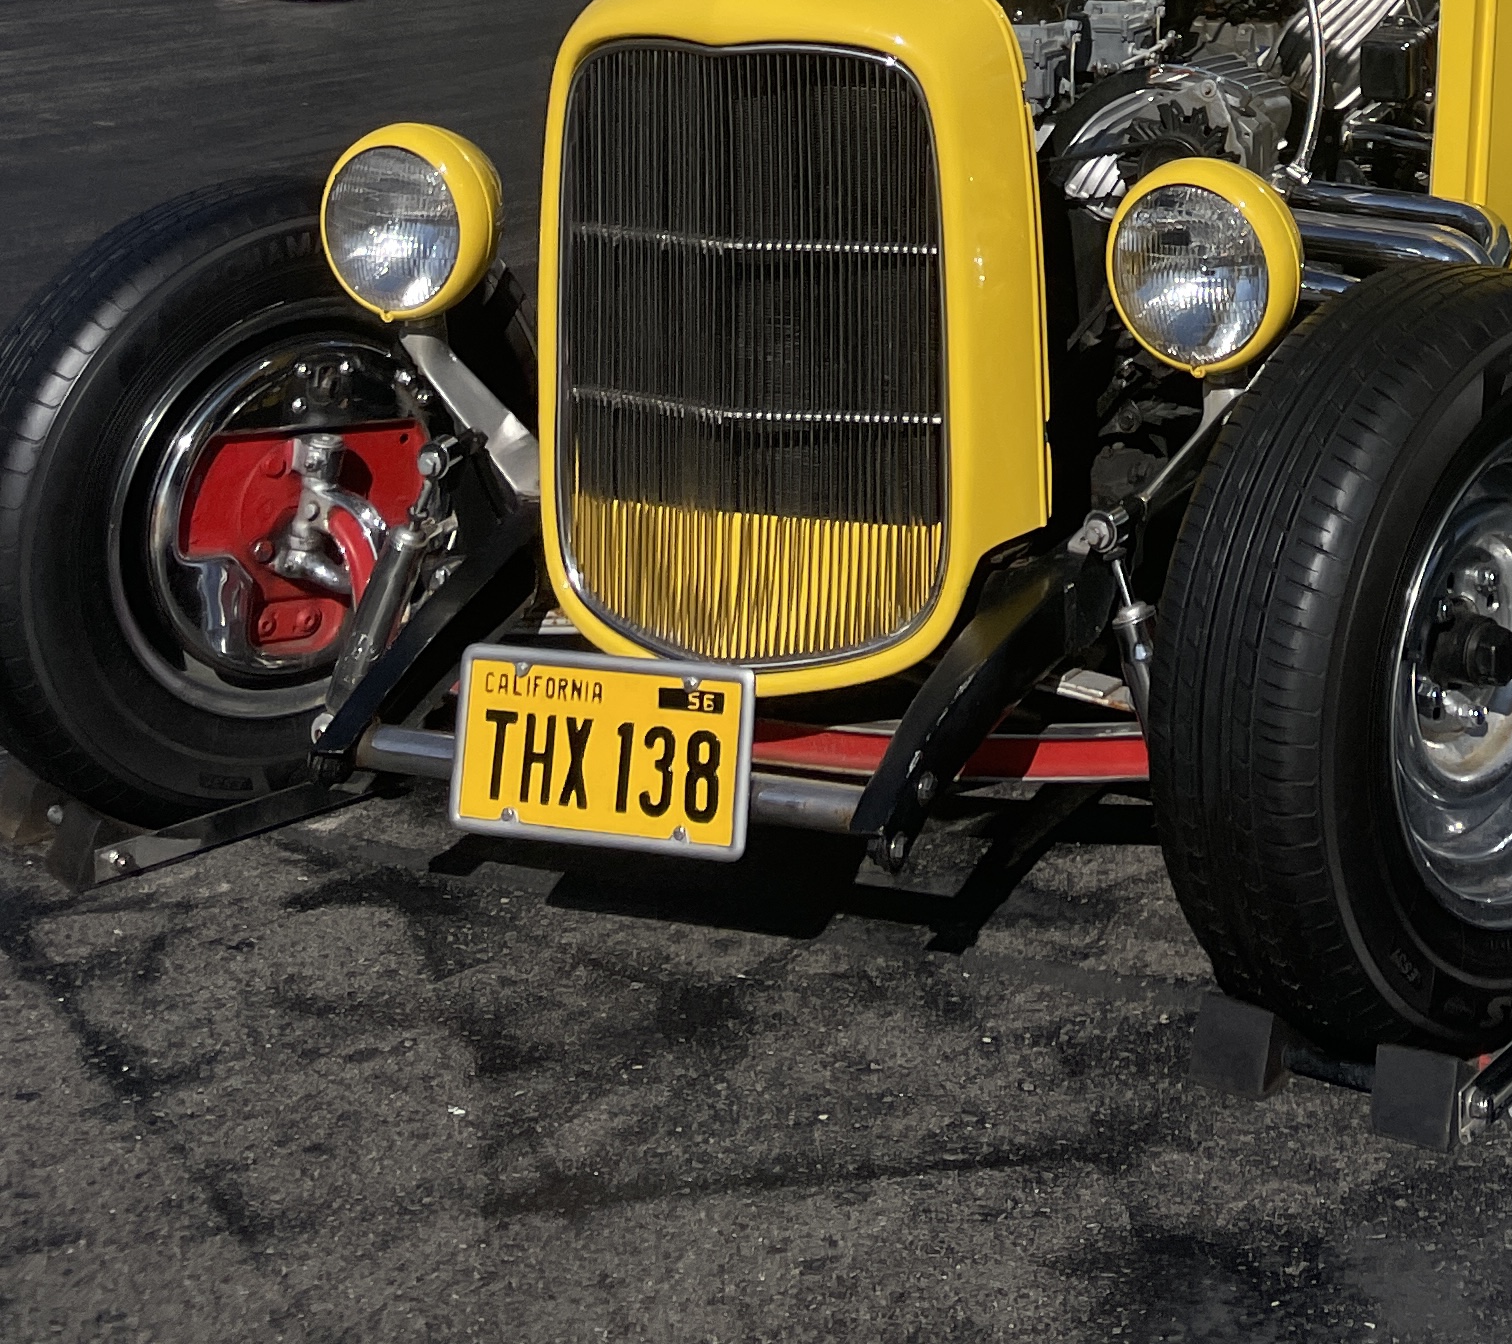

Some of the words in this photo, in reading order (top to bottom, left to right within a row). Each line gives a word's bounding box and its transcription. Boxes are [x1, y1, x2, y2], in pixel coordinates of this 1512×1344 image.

[485, 671, 603, 703] CALIFORNIA
[687, 691, 714, 711] 56
[485, 709, 593, 810] THX
[615, 722, 722, 824] 138
